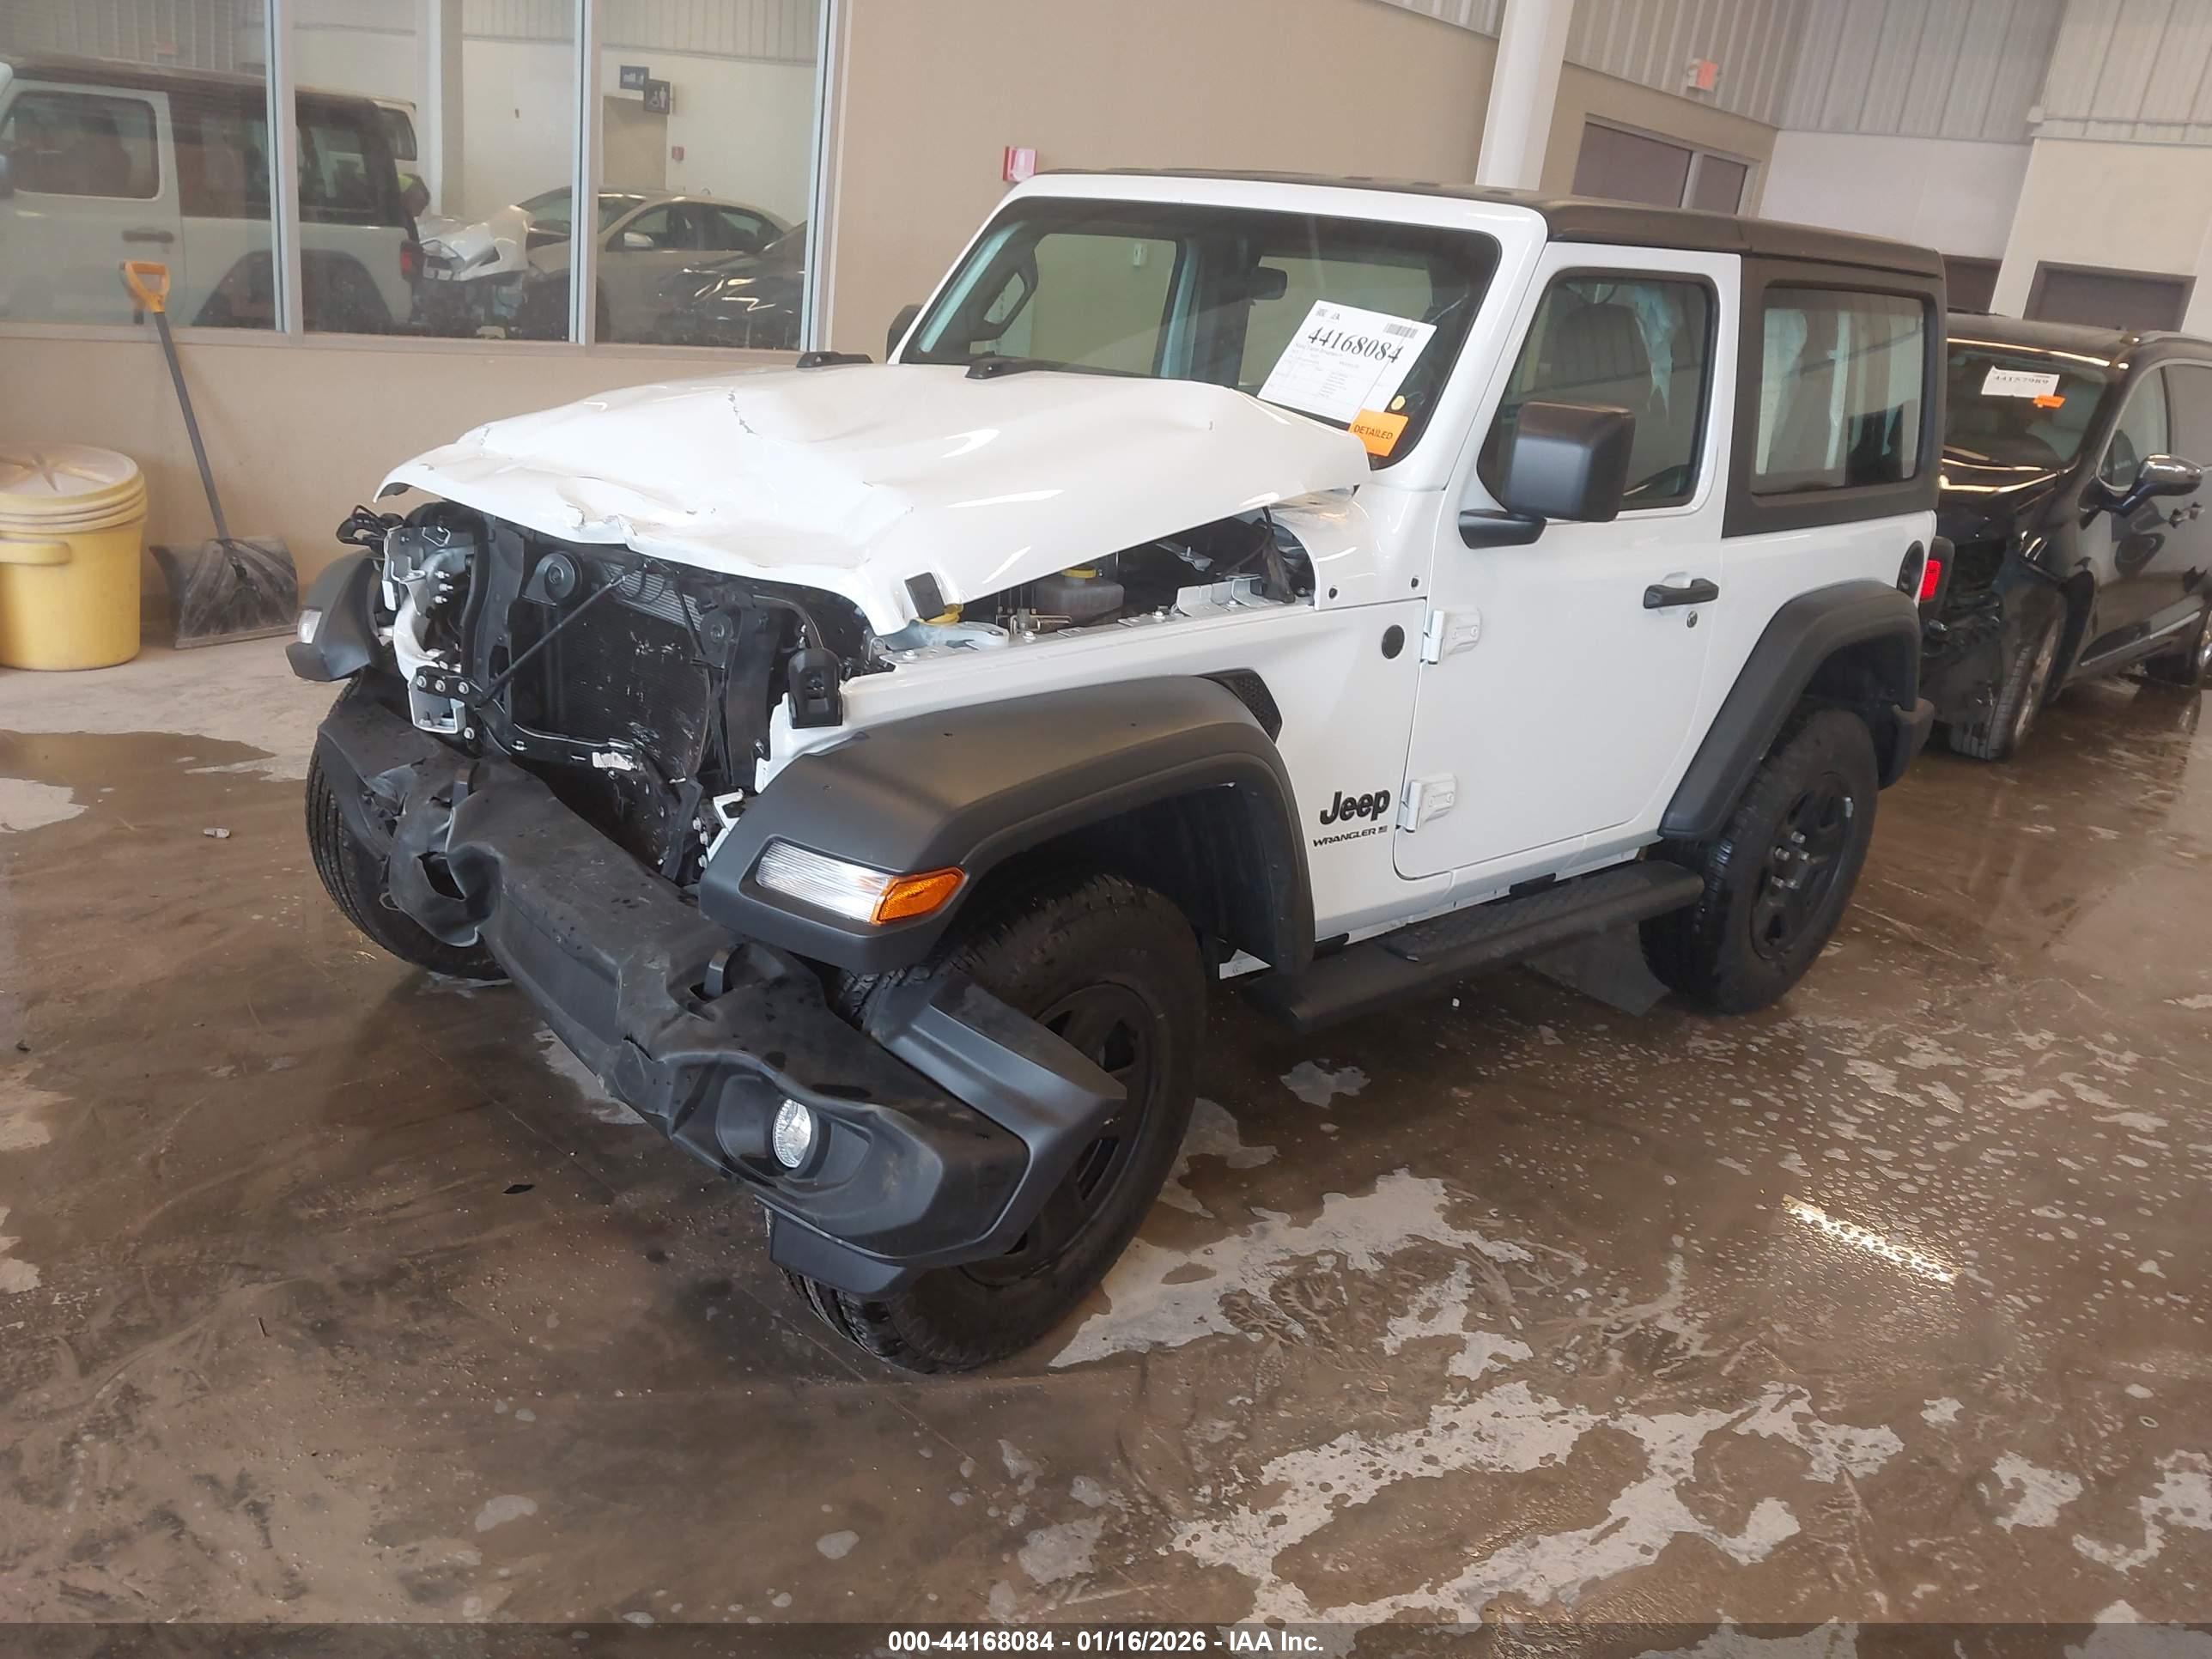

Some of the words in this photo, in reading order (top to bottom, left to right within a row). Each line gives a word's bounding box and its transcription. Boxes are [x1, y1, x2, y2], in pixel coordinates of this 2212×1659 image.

[1308, 325, 1404, 363] 44168084
[1353, 424, 1394, 441] DETAILED
[1319, 789, 1391, 825] Jeep
[1312, 827, 1376, 848] WRANGLER
